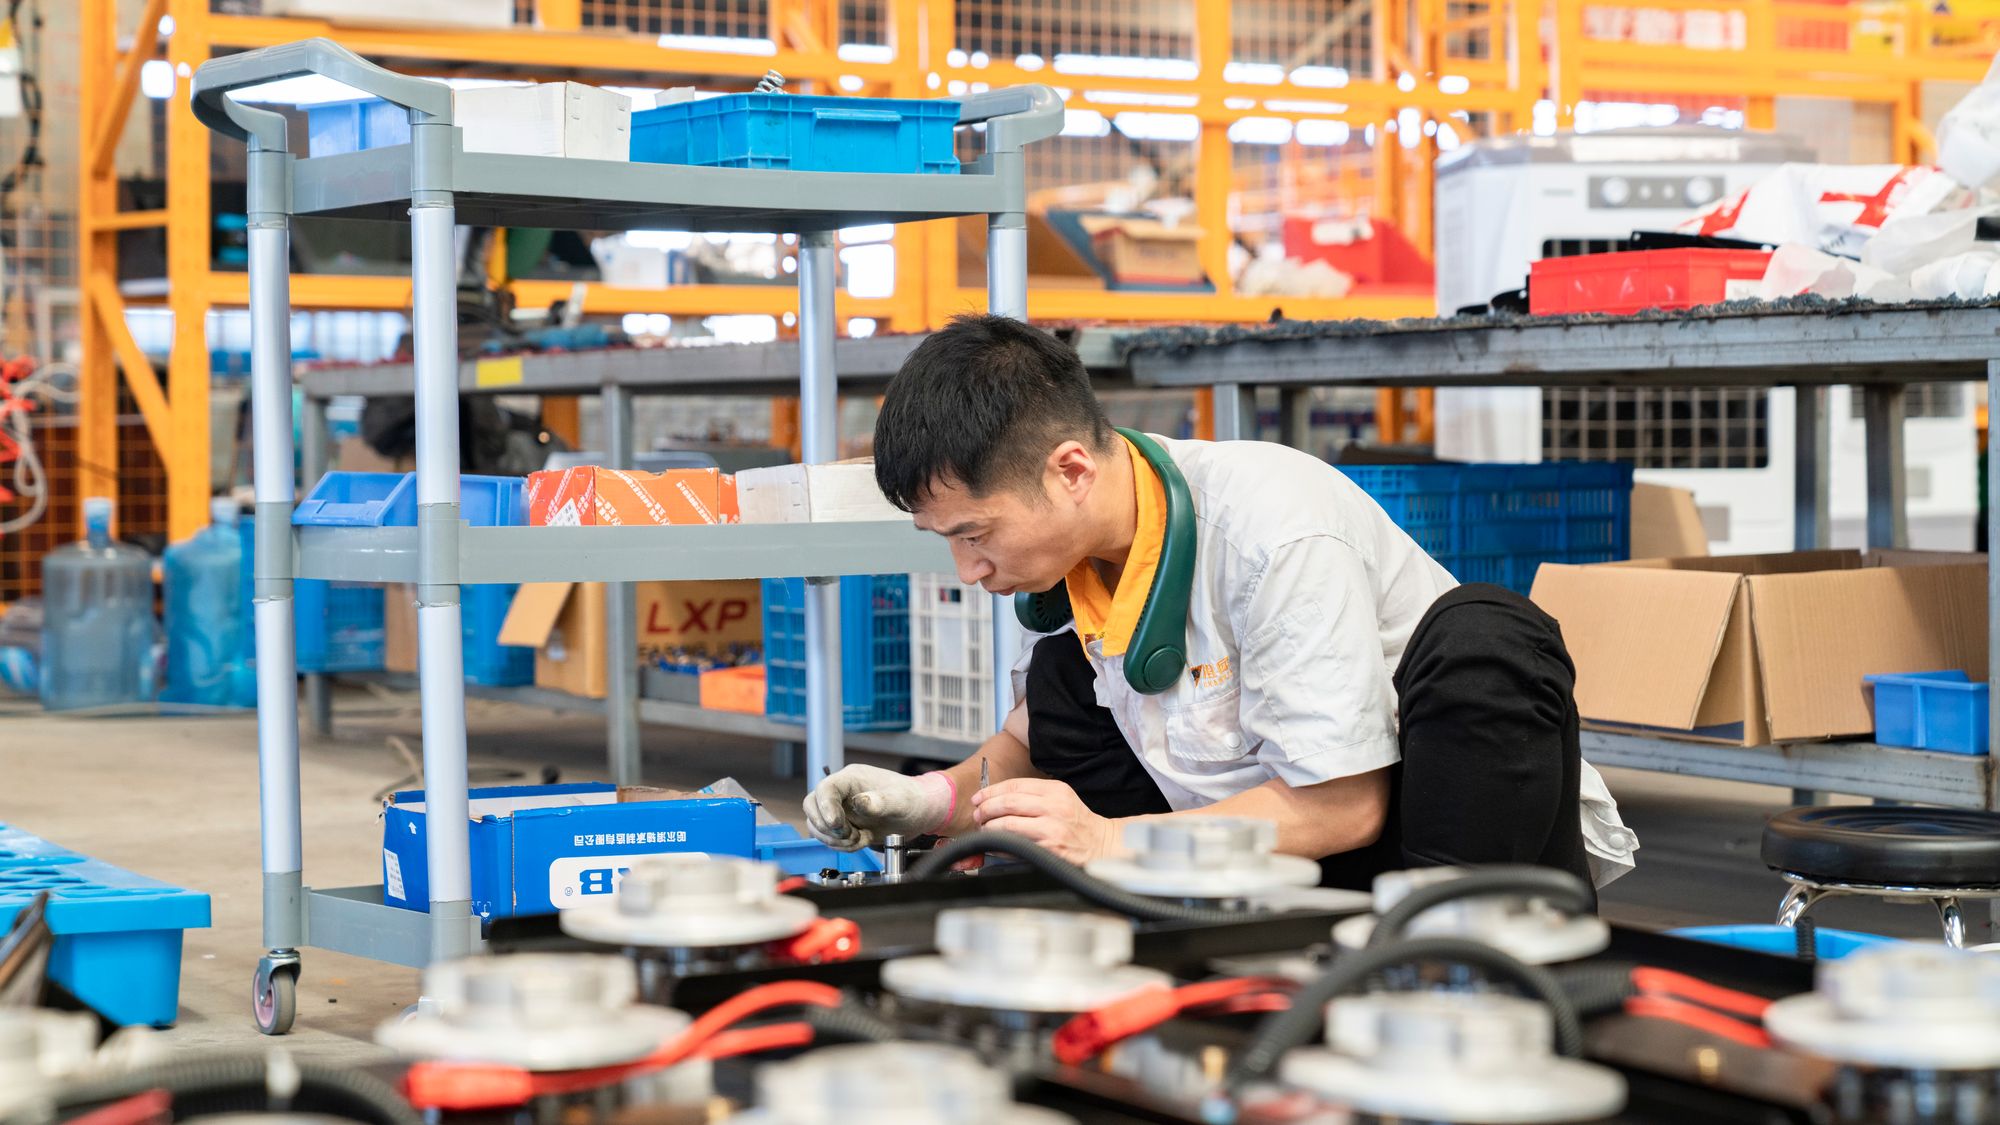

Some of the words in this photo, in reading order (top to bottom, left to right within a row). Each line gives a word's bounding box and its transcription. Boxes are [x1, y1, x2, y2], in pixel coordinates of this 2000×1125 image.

[646, 599, 750, 634] LXP
[574, 830, 687, 847] 哈尔滨轴承制造有限公司
